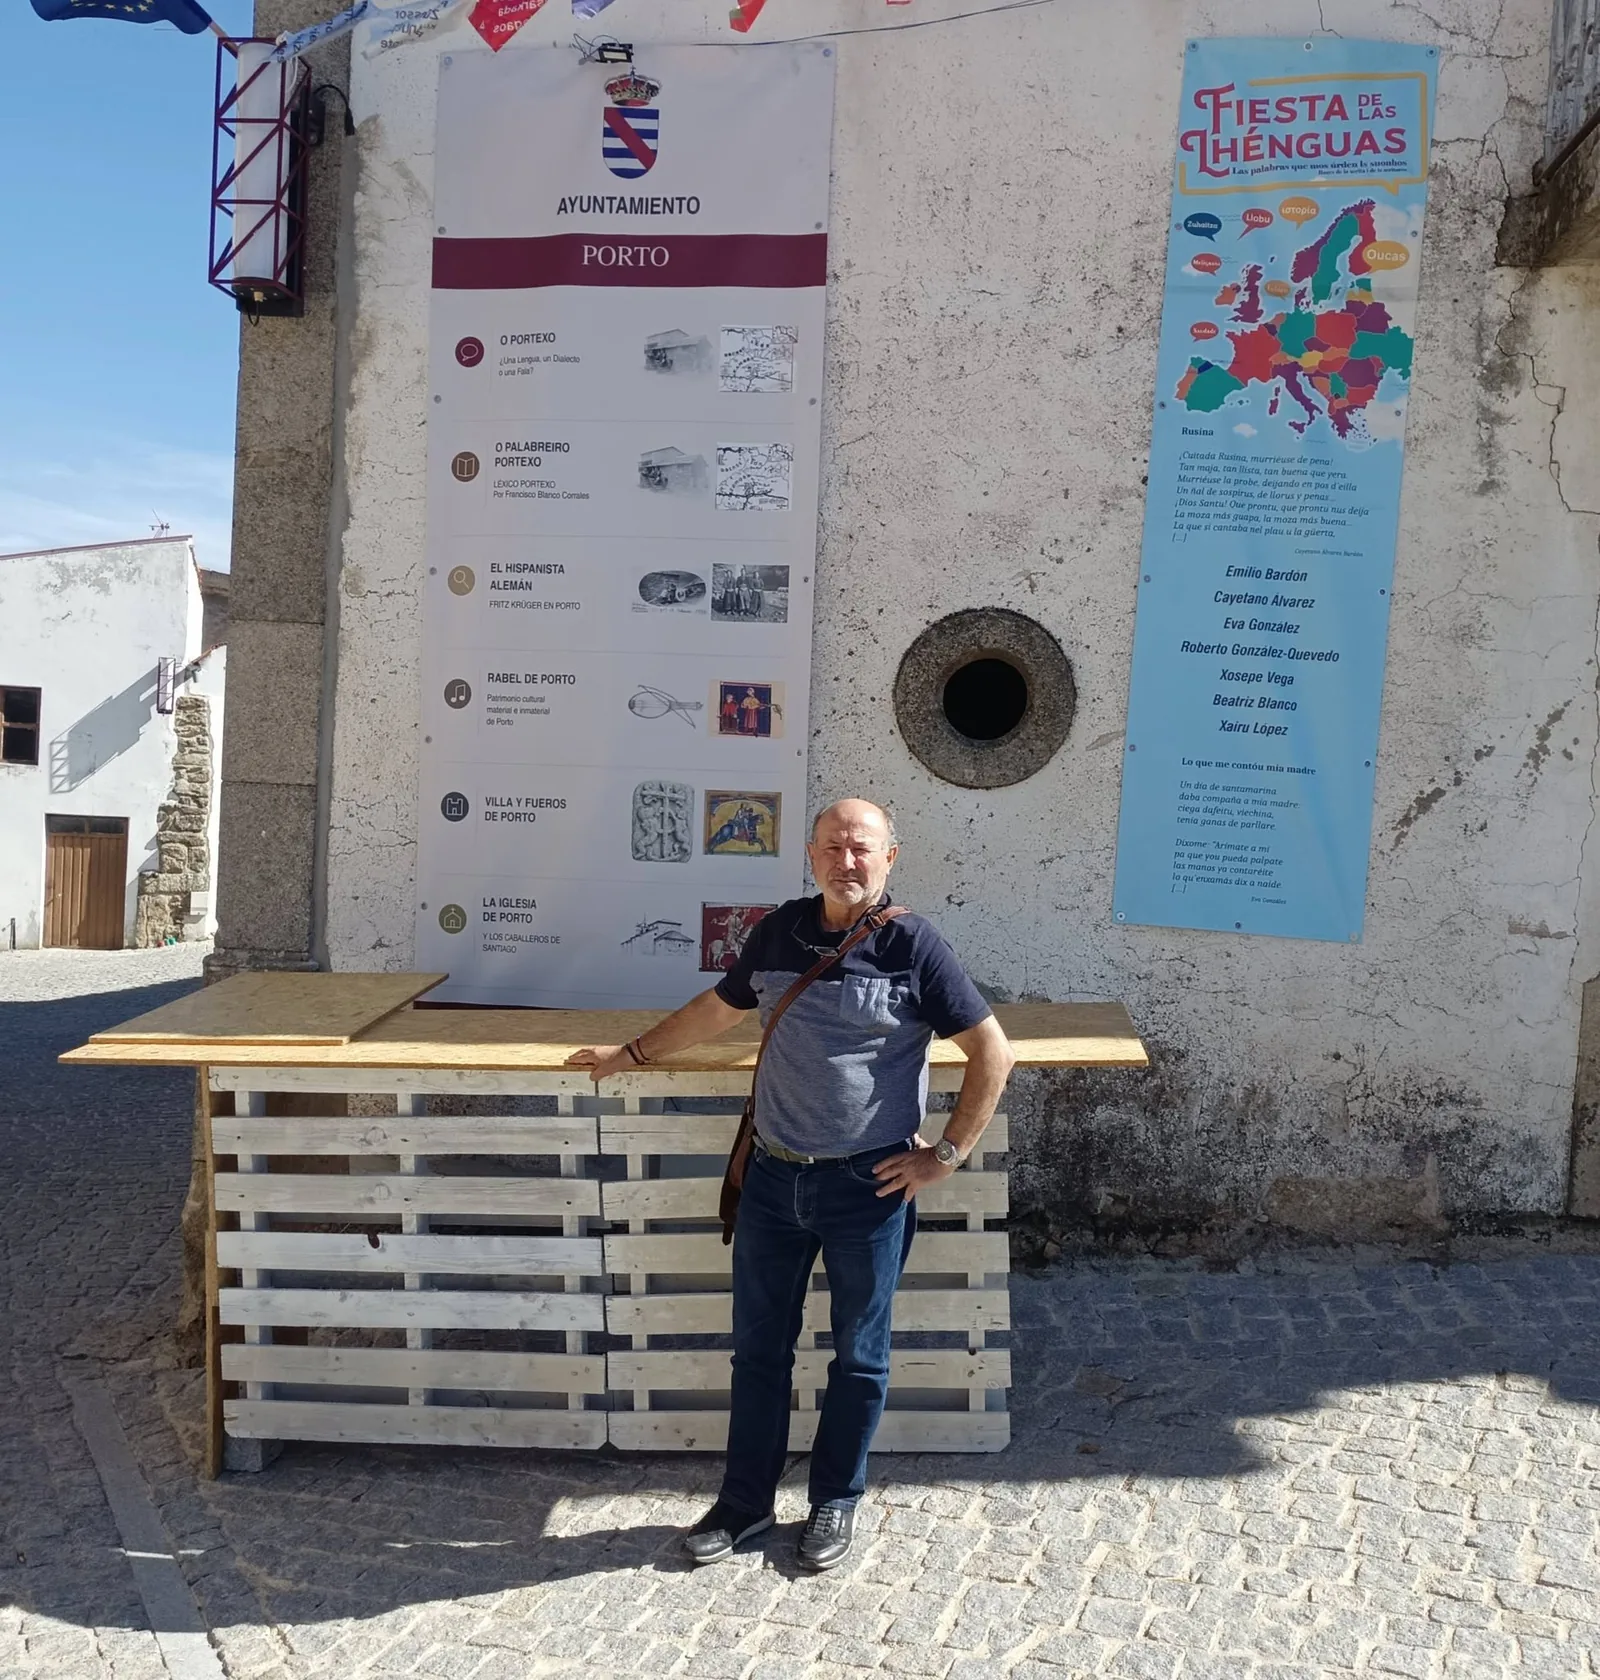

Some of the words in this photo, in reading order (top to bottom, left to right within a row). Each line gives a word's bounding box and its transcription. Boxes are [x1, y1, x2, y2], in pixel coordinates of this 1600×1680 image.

[1358, 93, 1382, 106] DE
[1194, 82, 1349, 134] FIESTA
[1359, 106, 1396, 120] LAS
[1180, 126, 1407, 178] LHÉNGUAS
[1232, 167, 1248, 175] Las
[1251, 165, 1289, 175] palabras
[557, 195, 700, 216] AYUNTAMIENTO
[582, 245, 669, 268] PORTO
[1367, 248, 1406, 262] Oucas
[500, 335, 507, 345] O
[511, 332, 555, 345] PORTEXO
[500, 357, 516, 365] ¿Una
[553, 355, 580, 363] Dialecto
[517, 367, 533, 375] Fala?
[496, 443, 502, 452] O
[505, 442, 570, 452] PALABREIRO
[495, 457, 541, 467] PORTEXO
[1297, 456, 1309, 464] de
[1309, 458, 1334, 466] pena!
[1180, 462, 1195, 471] Tan
[1264, 468, 1279, 476] tan
[1281, 467, 1309, 476] buena
[1310, 470, 1326, 478] que
[494, 479, 518, 488] LÉXICO
[1177, 474, 1222, 484] Murriéuse
[1223, 476, 1232, 484] la
[1262, 478, 1300, 490] deijando
[1314, 482, 1329, 490] pos
[506, 490, 535, 498] Francisco
[538, 491, 560, 499] Blanco
[1177, 486, 1189, 494] Un
[1207, 487, 1218, 496] de
[1219, 489, 1255, 499] sospirus,
[1257, 490, 1269, 499] de
[1270, 491, 1295, 500] llorus
[1175, 498, 1197, 508] ¡Dios
[1199, 499, 1228, 508] Santu!
[1229, 500, 1246, 509] Que
[1247, 503, 1279, 512] prontu,
[1281, 505, 1298, 513] que
[1299, 505, 1329, 514] prontu
[1348, 506, 1370, 517] deija
[1175, 509, 1186, 518] La
[1232, 513, 1261, 523] guapa,
[1263, 514, 1272, 523] la
[1173, 521, 1184, 530] La
[1186, 524, 1203, 532] que
[1213, 524, 1249, 532] cantaba
[1250, 526, 1263, 534] nel
[1294, 527, 1303, 536] la
[491, 563, 502, 573] EL
[506, 563, 565, 574] HISPANISTA
[1226, 565, 1261, 579] Emilio
[1265, 568, 1308, 582] Bardón
[490, 578, 532, 591] ALEMÁN
[511, 600, 541, 609] KRÜGER
[555, 602, 580, 610] PORTO
[1214, 591, 1268, 606] Cayetano
[1272, 592, 1315, 608] Álvarez
[1224, 618, 1245, 629] Eva
[1249, 618, 1300, 633] González
[1181, 641, 1227, 655] Roberto
[1232, 644, 1339, 663] González-Quevedo
[488, 673, 522, 683] RABEL
[525, 674, 538, 684] DE
[541, 675, 575, 684] PORTO
[1220, 669, 1263, 684] Xosepe
[1267, 672, 1294, 686] Vega
[487, 694, 521, 702] Patrimonio
[1213, 694, 1253, 708] Beatriz
[1258, 697, 1297, 711] Blanco
[1219, 720, 1249, 733] Xairu
[1253, 722, 1288, 737] López
[1182, 757, 1194, 766] Lo
[1196, 760, 1214, 769] que
[1232, 762, 1264, 771] contóu
[1287, 766, 1317, 775] madre
[1180, 781, 1192, 789] Un
[1209, 783, 1221, 791] de
[1222, 785, 1277, 795] santamarina
[485, 797, 513, 807] VILLA
[517, 798, 522, 807] Y
[526, 798, 566, 808] FUEROS
[1179, 792, 1201, 801] daba
[1178, 804, 1201, 814] ciega
[485, 811, 498, 821] DE
[501, 812, 535, 822] PORTO
[1200, 819, 1227, 827] ganas
[1228, 819, 1239, 827] de
[1174, 851, 1185, 859] pa
[1205, 854, 1221, 862] you
[1222, 854, 1249, 863] pueda
[1250, 856, 1284, 866] palpate
[1173, 861, 1186, 870] las
[1188, 864, 1216, 872] manos
[1218, 866, 1228, 874] ya
[1172, 872, 1181, 881] lo
[483, 898, 496, 907] LA
[500, 898, 536, 909] IGLESIA
[483, 912, 496, 921] DE
[500, 913, 532, 923] PORTO
[490, 933, 503, 941] LOS
[505, 934, 549, 943] CABALLEROS
[551, 936, 560, 944] DE
[483, 944, 516, 953] SANTIAGO
